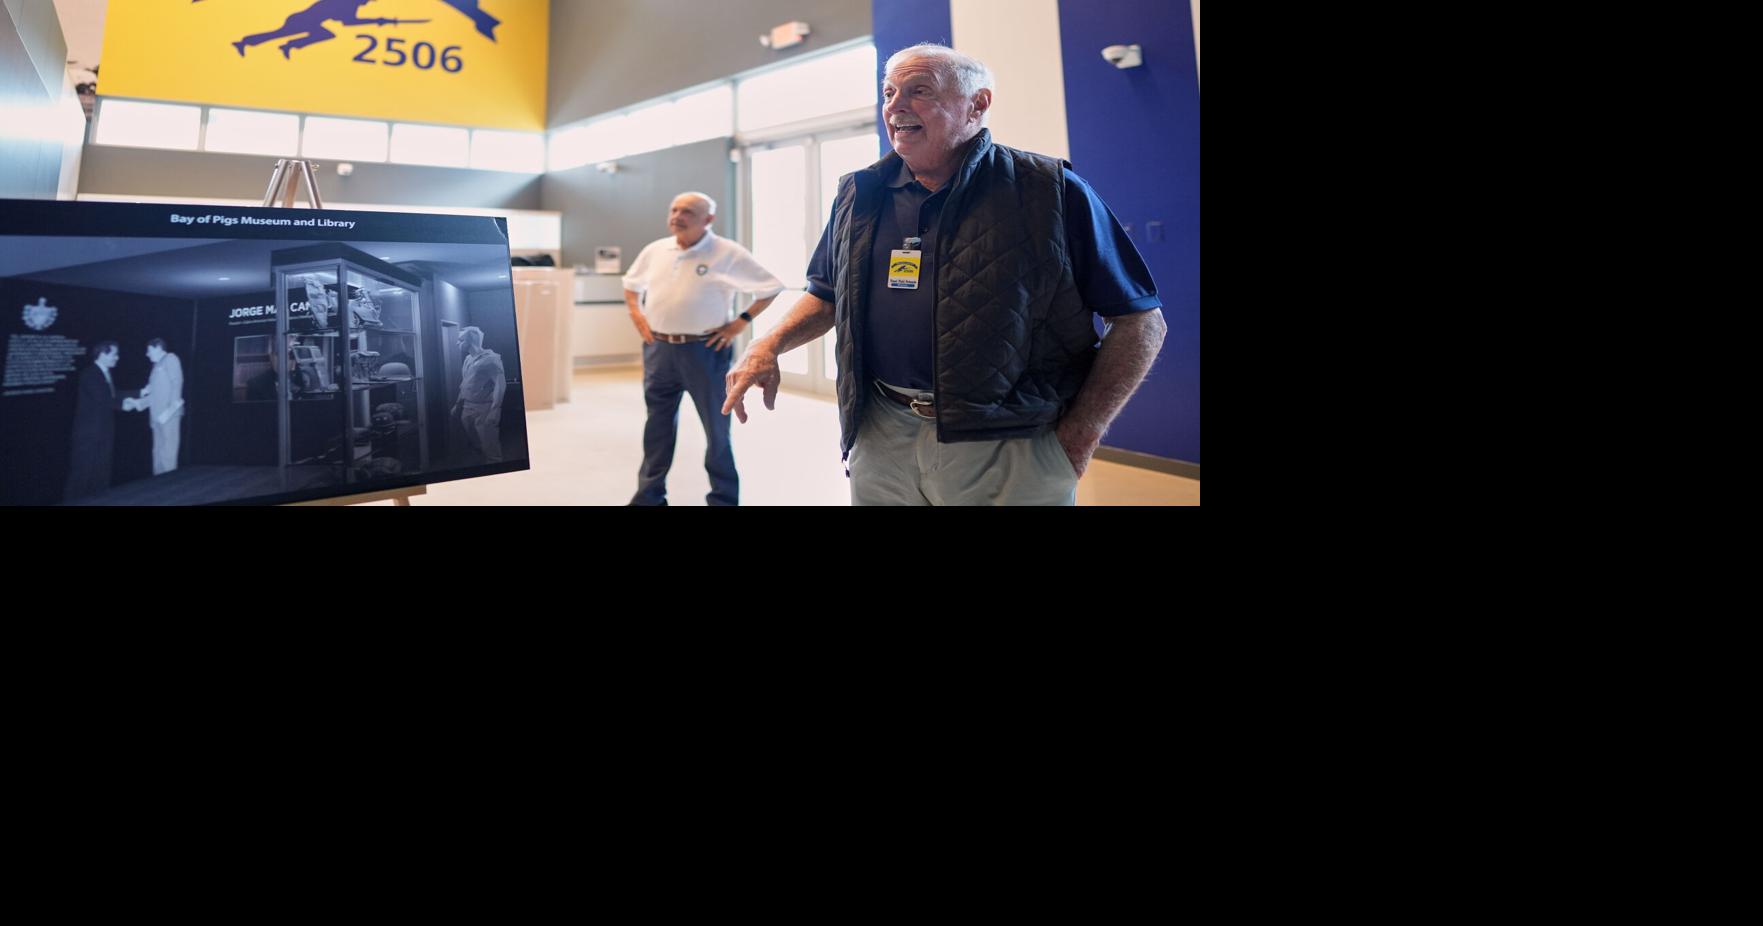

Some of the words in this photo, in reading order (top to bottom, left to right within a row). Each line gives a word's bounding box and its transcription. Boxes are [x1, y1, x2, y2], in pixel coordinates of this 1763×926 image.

[352, 34, 463, 73] 2506
[170, 213, 195, 225] Bay
[196, 214, 212, 224] of
[212, 215, 240, 226] Pigs
[240, 216, 292, 226] Museum
[293, 218, 315, 226] and
[317, 218, 356, 229] Library
[229, 306, 264, 318] JORGE
